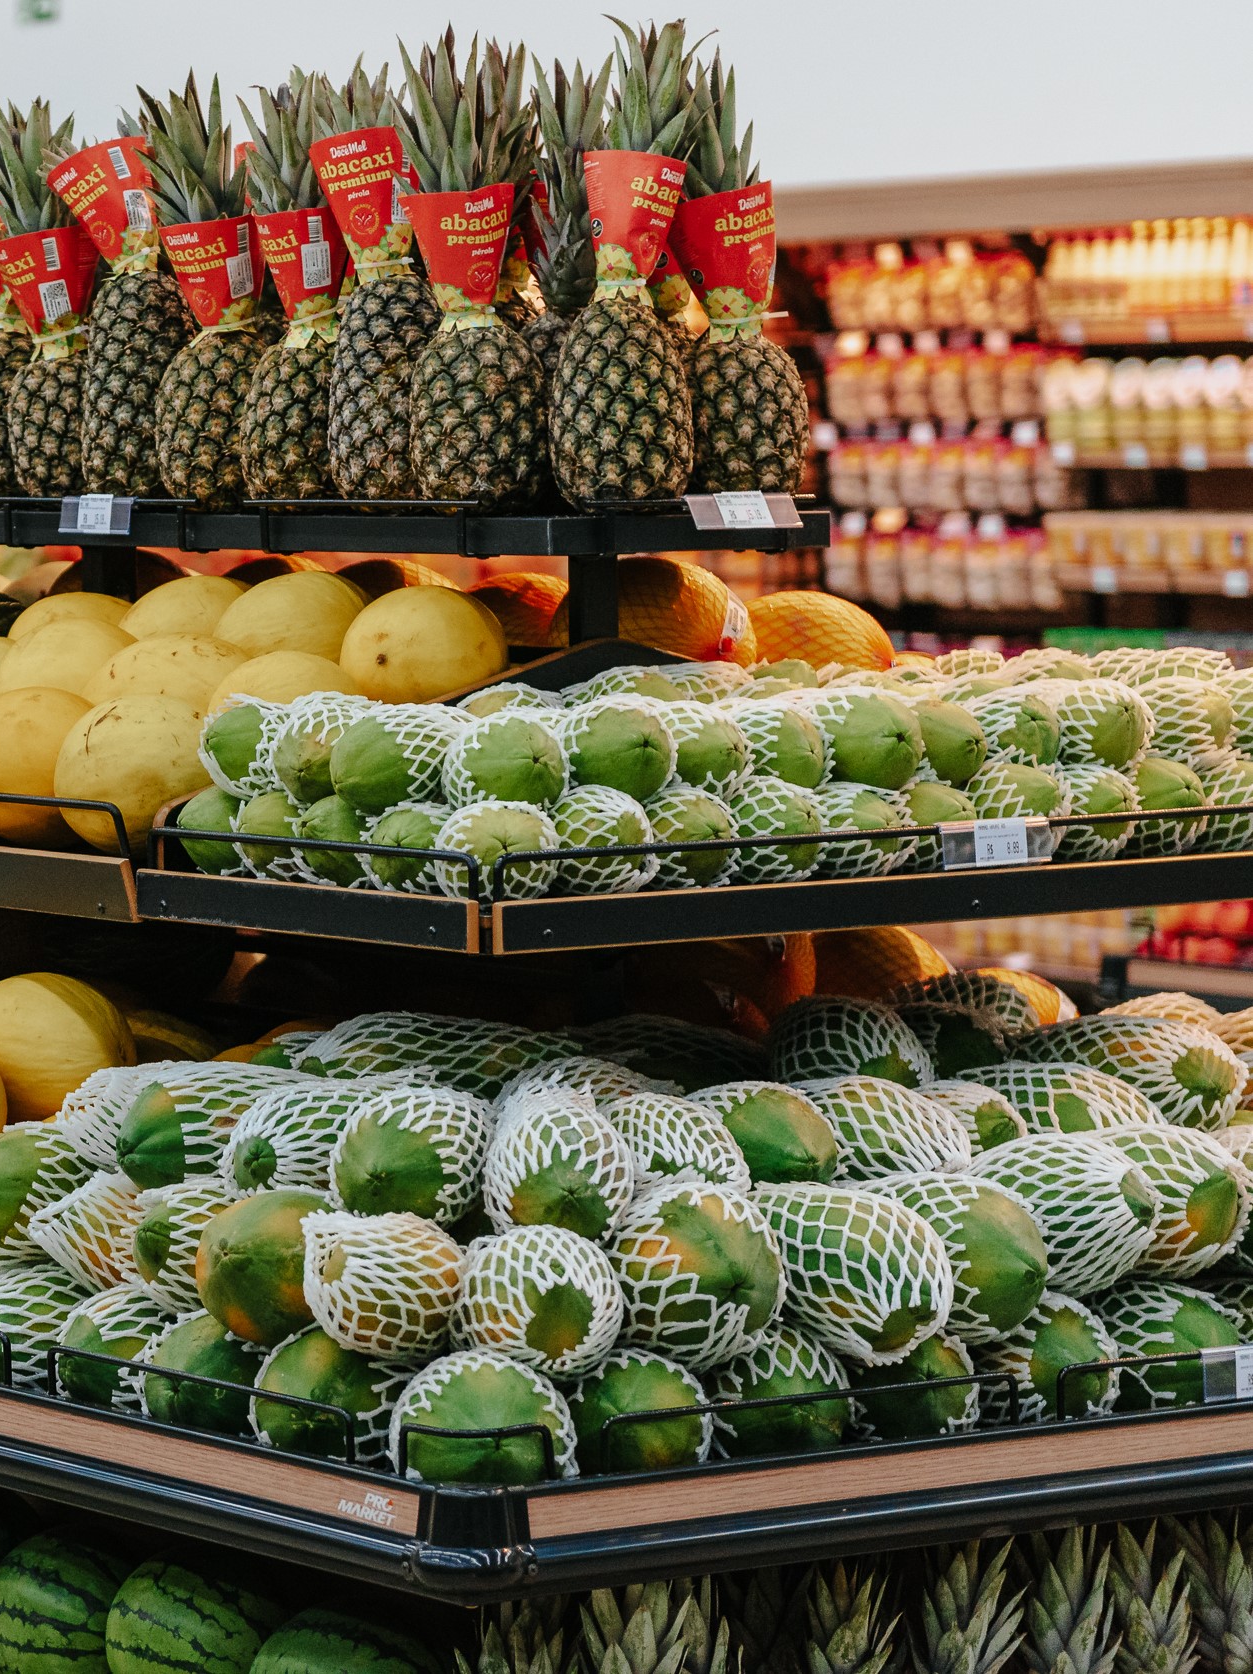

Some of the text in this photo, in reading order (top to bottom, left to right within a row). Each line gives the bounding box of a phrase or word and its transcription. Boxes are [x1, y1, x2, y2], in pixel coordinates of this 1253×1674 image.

[320, 146, 394, 180] abacaxi
[63, 163, 107, 205] acaxi
[328, 169, 392, 194] premium
[440, 203, 508, 231] abacaxi
[714, 205, 775, 232] abacax
[261, 229, 299, 252] caxi
[447, 227, 505, 246] premium
[337, 1499, 396, 1526] MARKET
[364, 1492, 394, 1511] PRO
